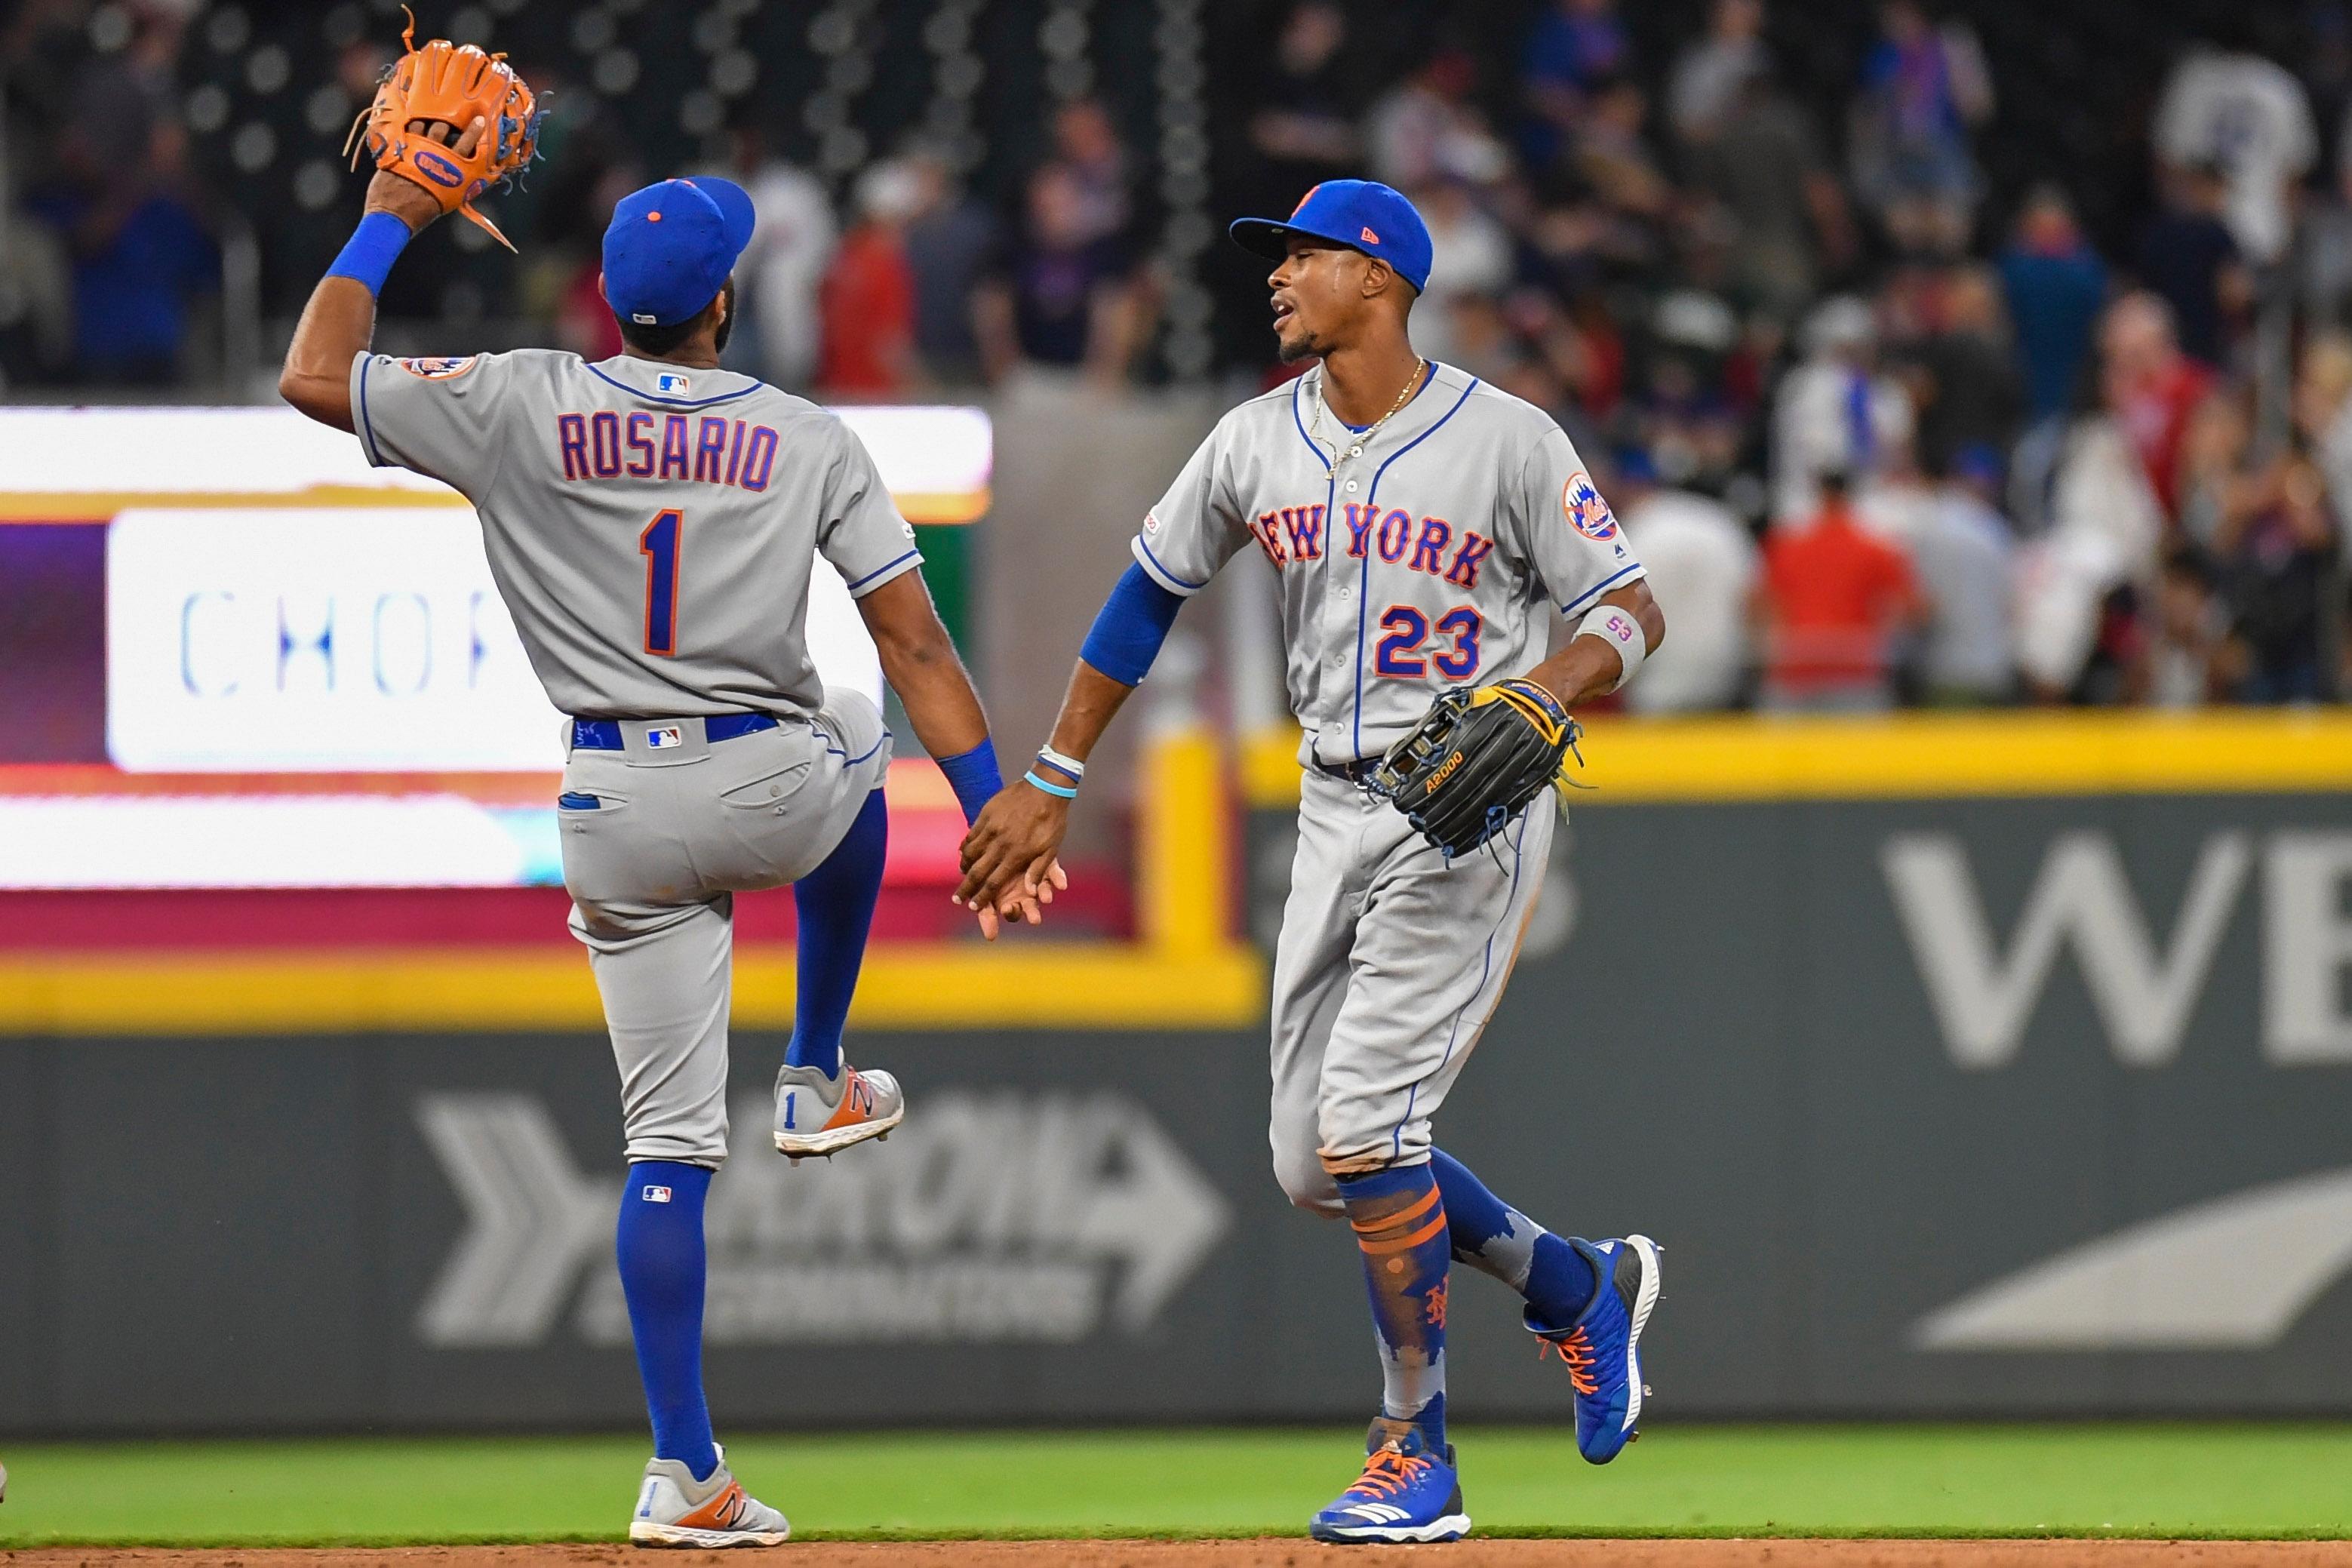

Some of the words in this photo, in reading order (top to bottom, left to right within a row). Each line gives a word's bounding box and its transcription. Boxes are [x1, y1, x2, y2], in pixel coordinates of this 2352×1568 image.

[557, 410, 780, 493] ROSARIO
[639, 507, 684, 658] 1
[1343, 502, 1495, 590] YORK
[1374, 604, 1484, 680] 23
[1606, 615, 1632, 641] 53
[1425, 751, 1463, 795] A2000
[783, 1091, 796, 1130] 1
